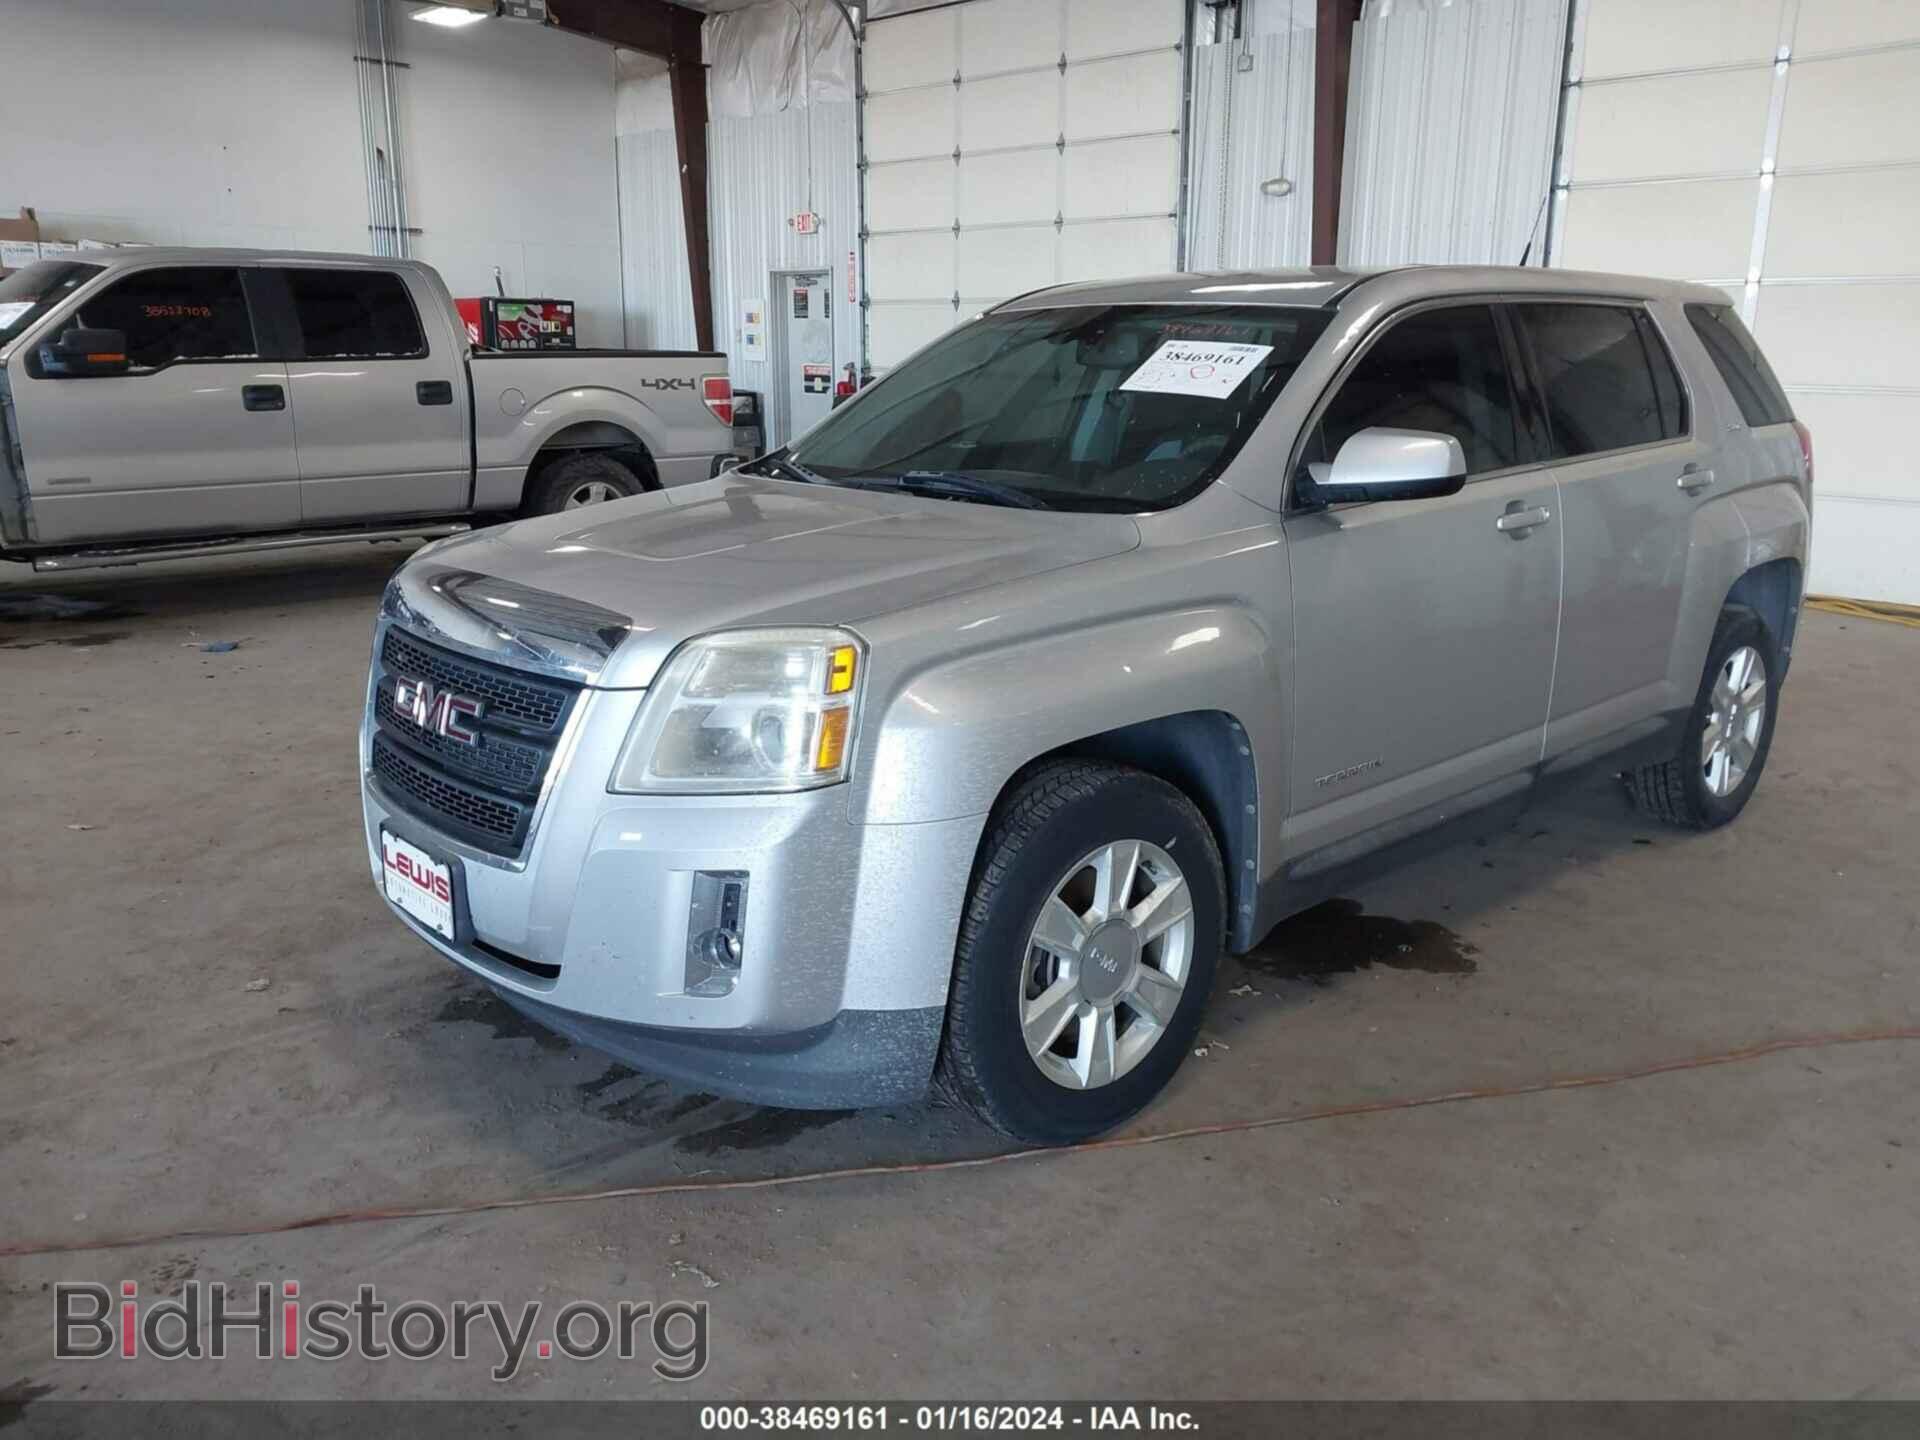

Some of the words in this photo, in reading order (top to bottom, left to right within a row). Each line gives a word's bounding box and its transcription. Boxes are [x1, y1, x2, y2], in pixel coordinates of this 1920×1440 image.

[1165, 350, 1246, 365] 38469161
[395, 676, 484, 746] GMC
[383, 844, 450, 903] LEWIS
